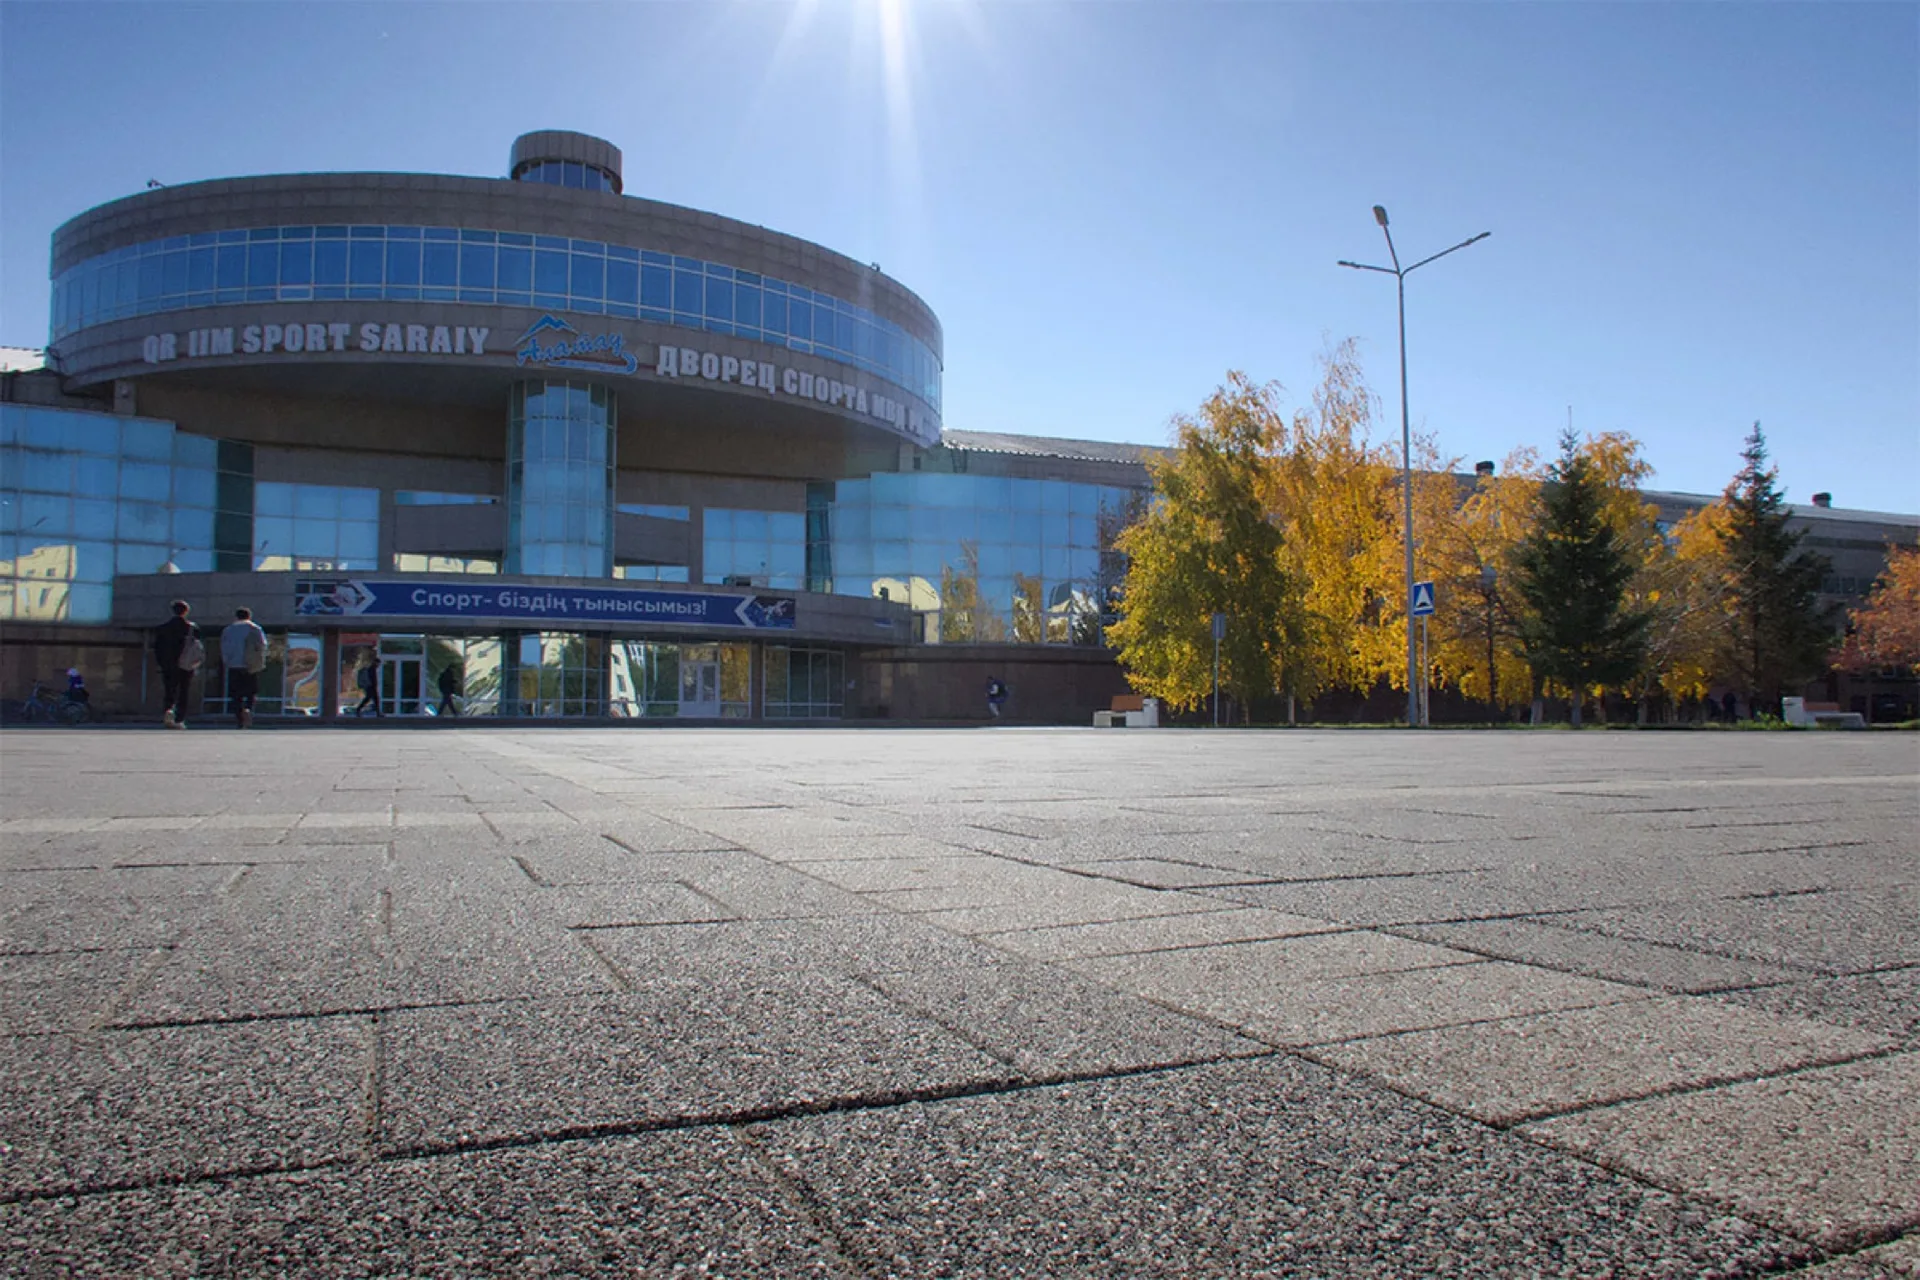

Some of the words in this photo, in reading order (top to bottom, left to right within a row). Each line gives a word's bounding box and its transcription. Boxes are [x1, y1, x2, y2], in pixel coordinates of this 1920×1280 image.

[143, 334, 177, 364] QR
[243, 323, 349, 354] SPORT
[360, 323, 489, 355] SARAIY
[656, 345, 776, 394] ДВОРЕЦ
[783, 367, 868, 415] СПОРТА
[498, 591, 568, 613] біздің
[572, 597, 708, 616] тынысымыз!
